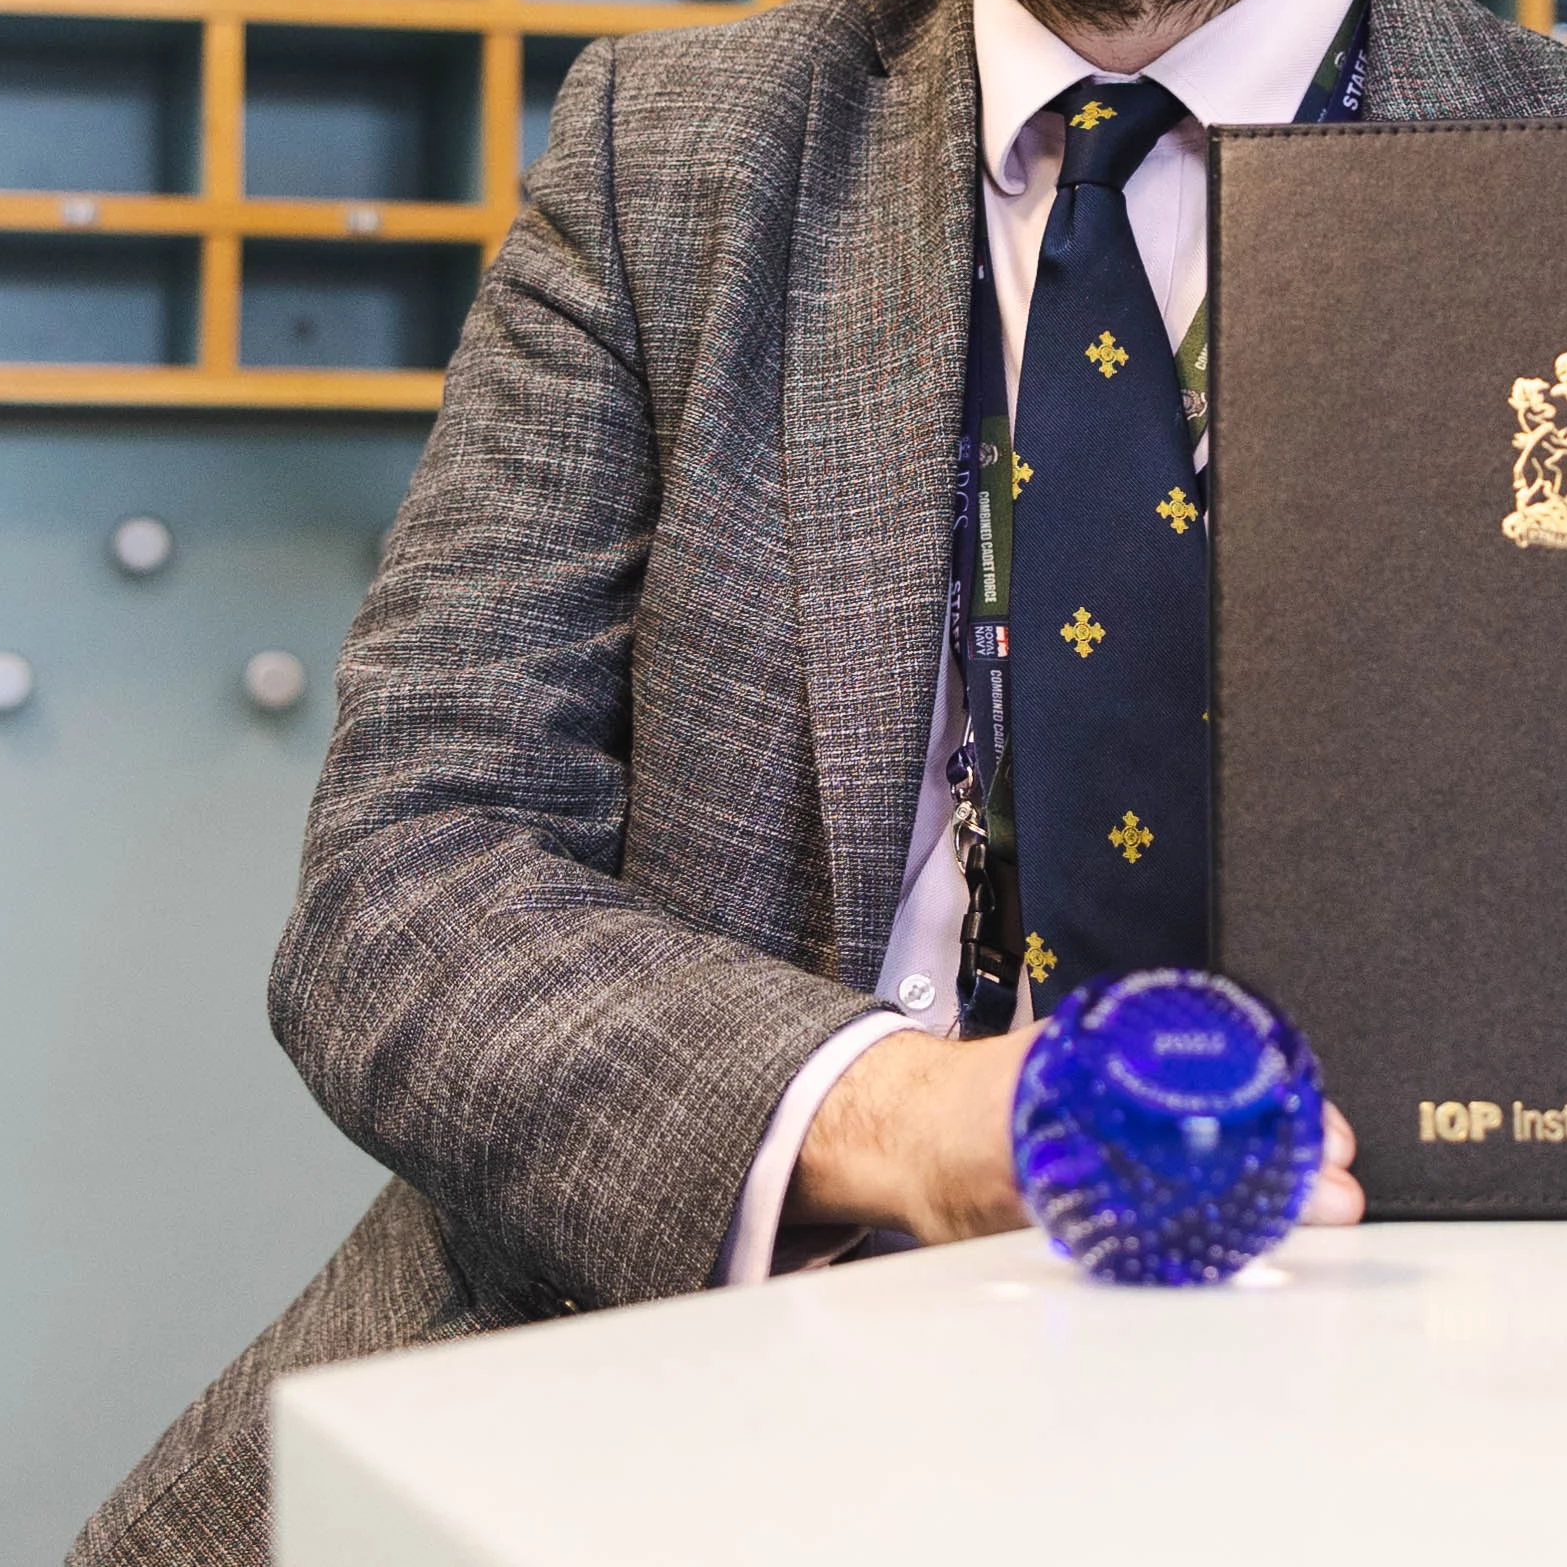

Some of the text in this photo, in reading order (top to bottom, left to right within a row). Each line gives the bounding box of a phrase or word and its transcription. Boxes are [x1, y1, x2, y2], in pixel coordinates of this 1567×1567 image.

[979, 491, 998, 603] COMBINED CADET FORCE
[974, 625, 986, 657] NAVY
[984, 625, 995, 656] ROYAL
[990, 669, 1003, 722] COMBINED
[1419, 1100, 1502, 1143] IOP
